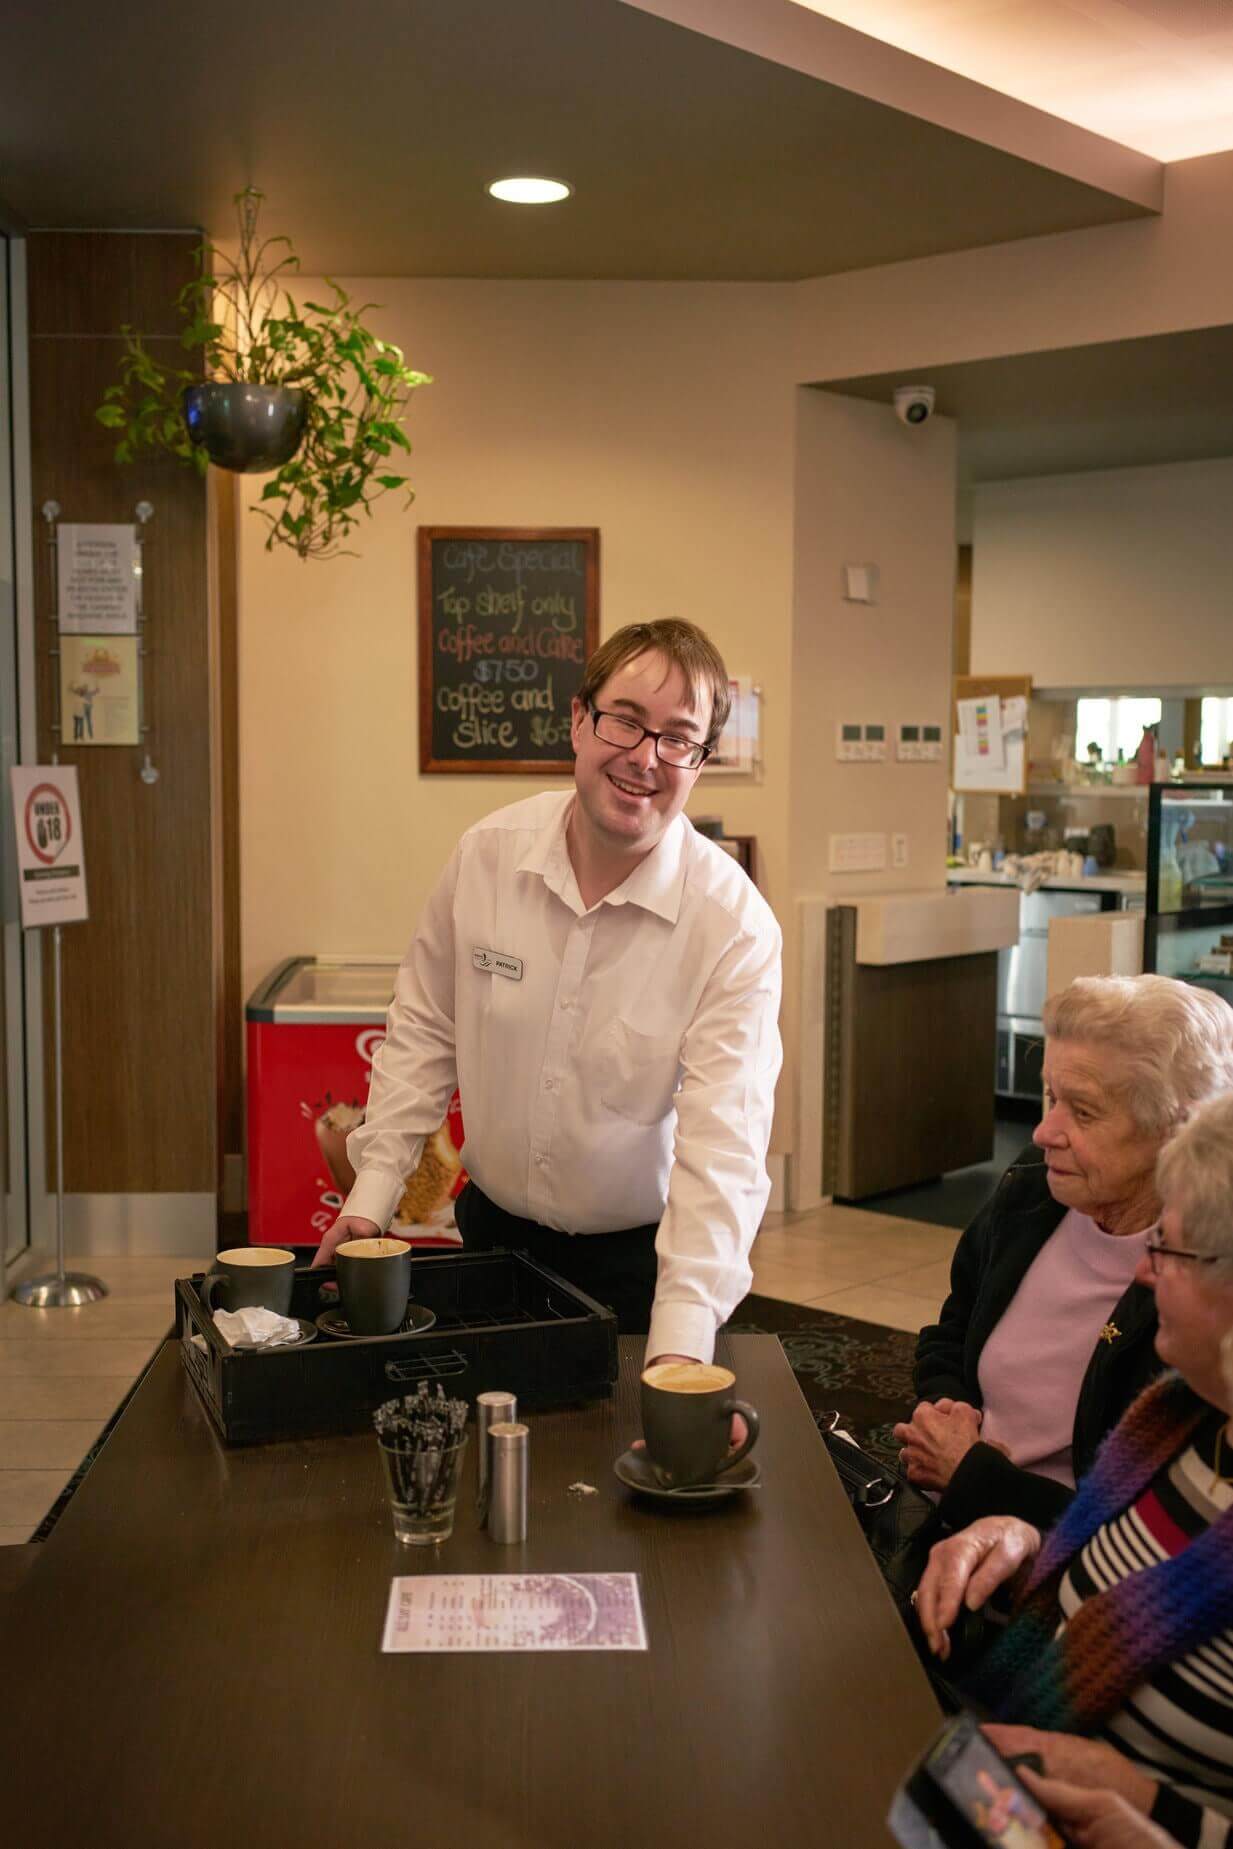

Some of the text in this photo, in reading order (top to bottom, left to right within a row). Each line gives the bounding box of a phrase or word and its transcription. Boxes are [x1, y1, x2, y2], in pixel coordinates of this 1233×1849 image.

[437, 586, 470, 625] Top
[531, 590, 577, 632] only
[511, 672, 555, 711] and
[47, 817, 61, 841] 18
[495, 960, 518, 971] PATRICK
